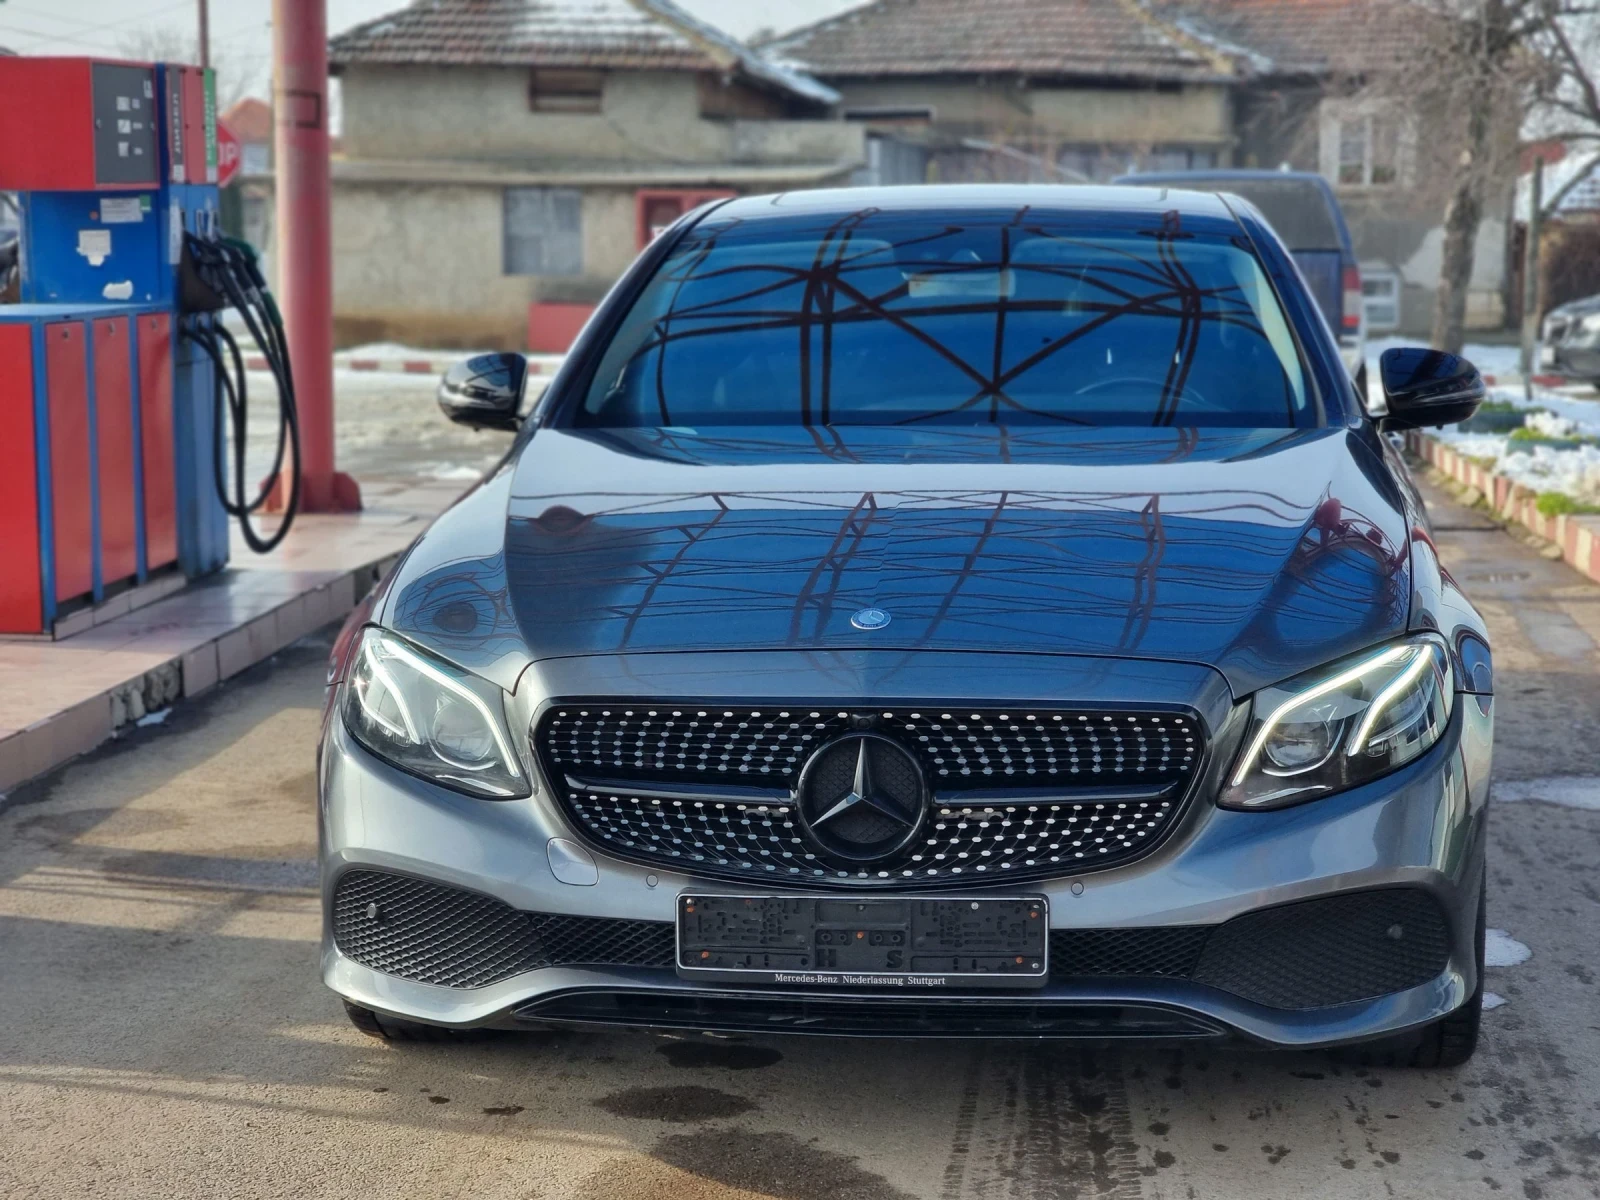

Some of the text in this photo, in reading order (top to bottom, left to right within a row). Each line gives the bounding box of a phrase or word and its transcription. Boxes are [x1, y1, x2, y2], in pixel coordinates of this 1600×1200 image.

[775, 973, 946, 987] Mercedes-Benz Niederlassung Stuttgart
